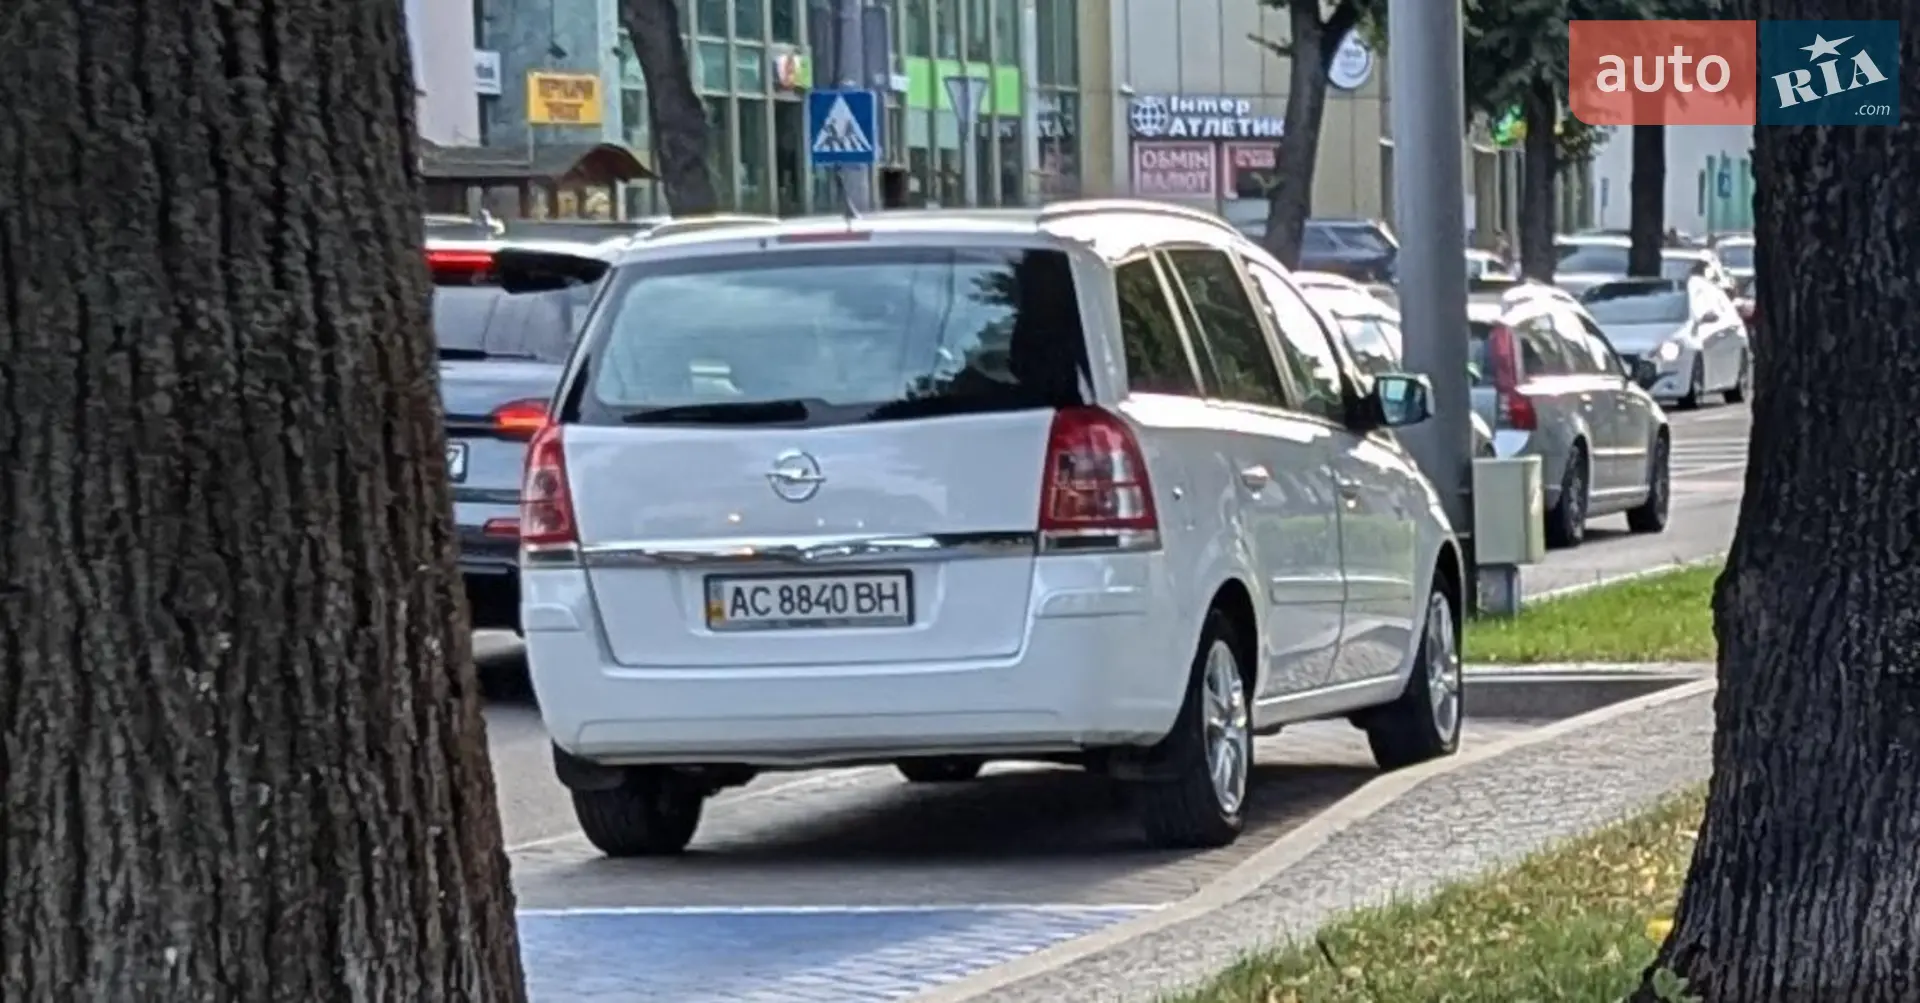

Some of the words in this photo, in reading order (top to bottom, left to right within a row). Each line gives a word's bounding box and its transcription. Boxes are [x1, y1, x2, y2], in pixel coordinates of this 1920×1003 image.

[1170, 96, 1250, 116] Інтер
[1142, 150, 1210, 169] ОБМІН
[730, 586, 771, 617] AC
[778, 584, 849, 615] 8840
[854, 581, 900, 613] BH
